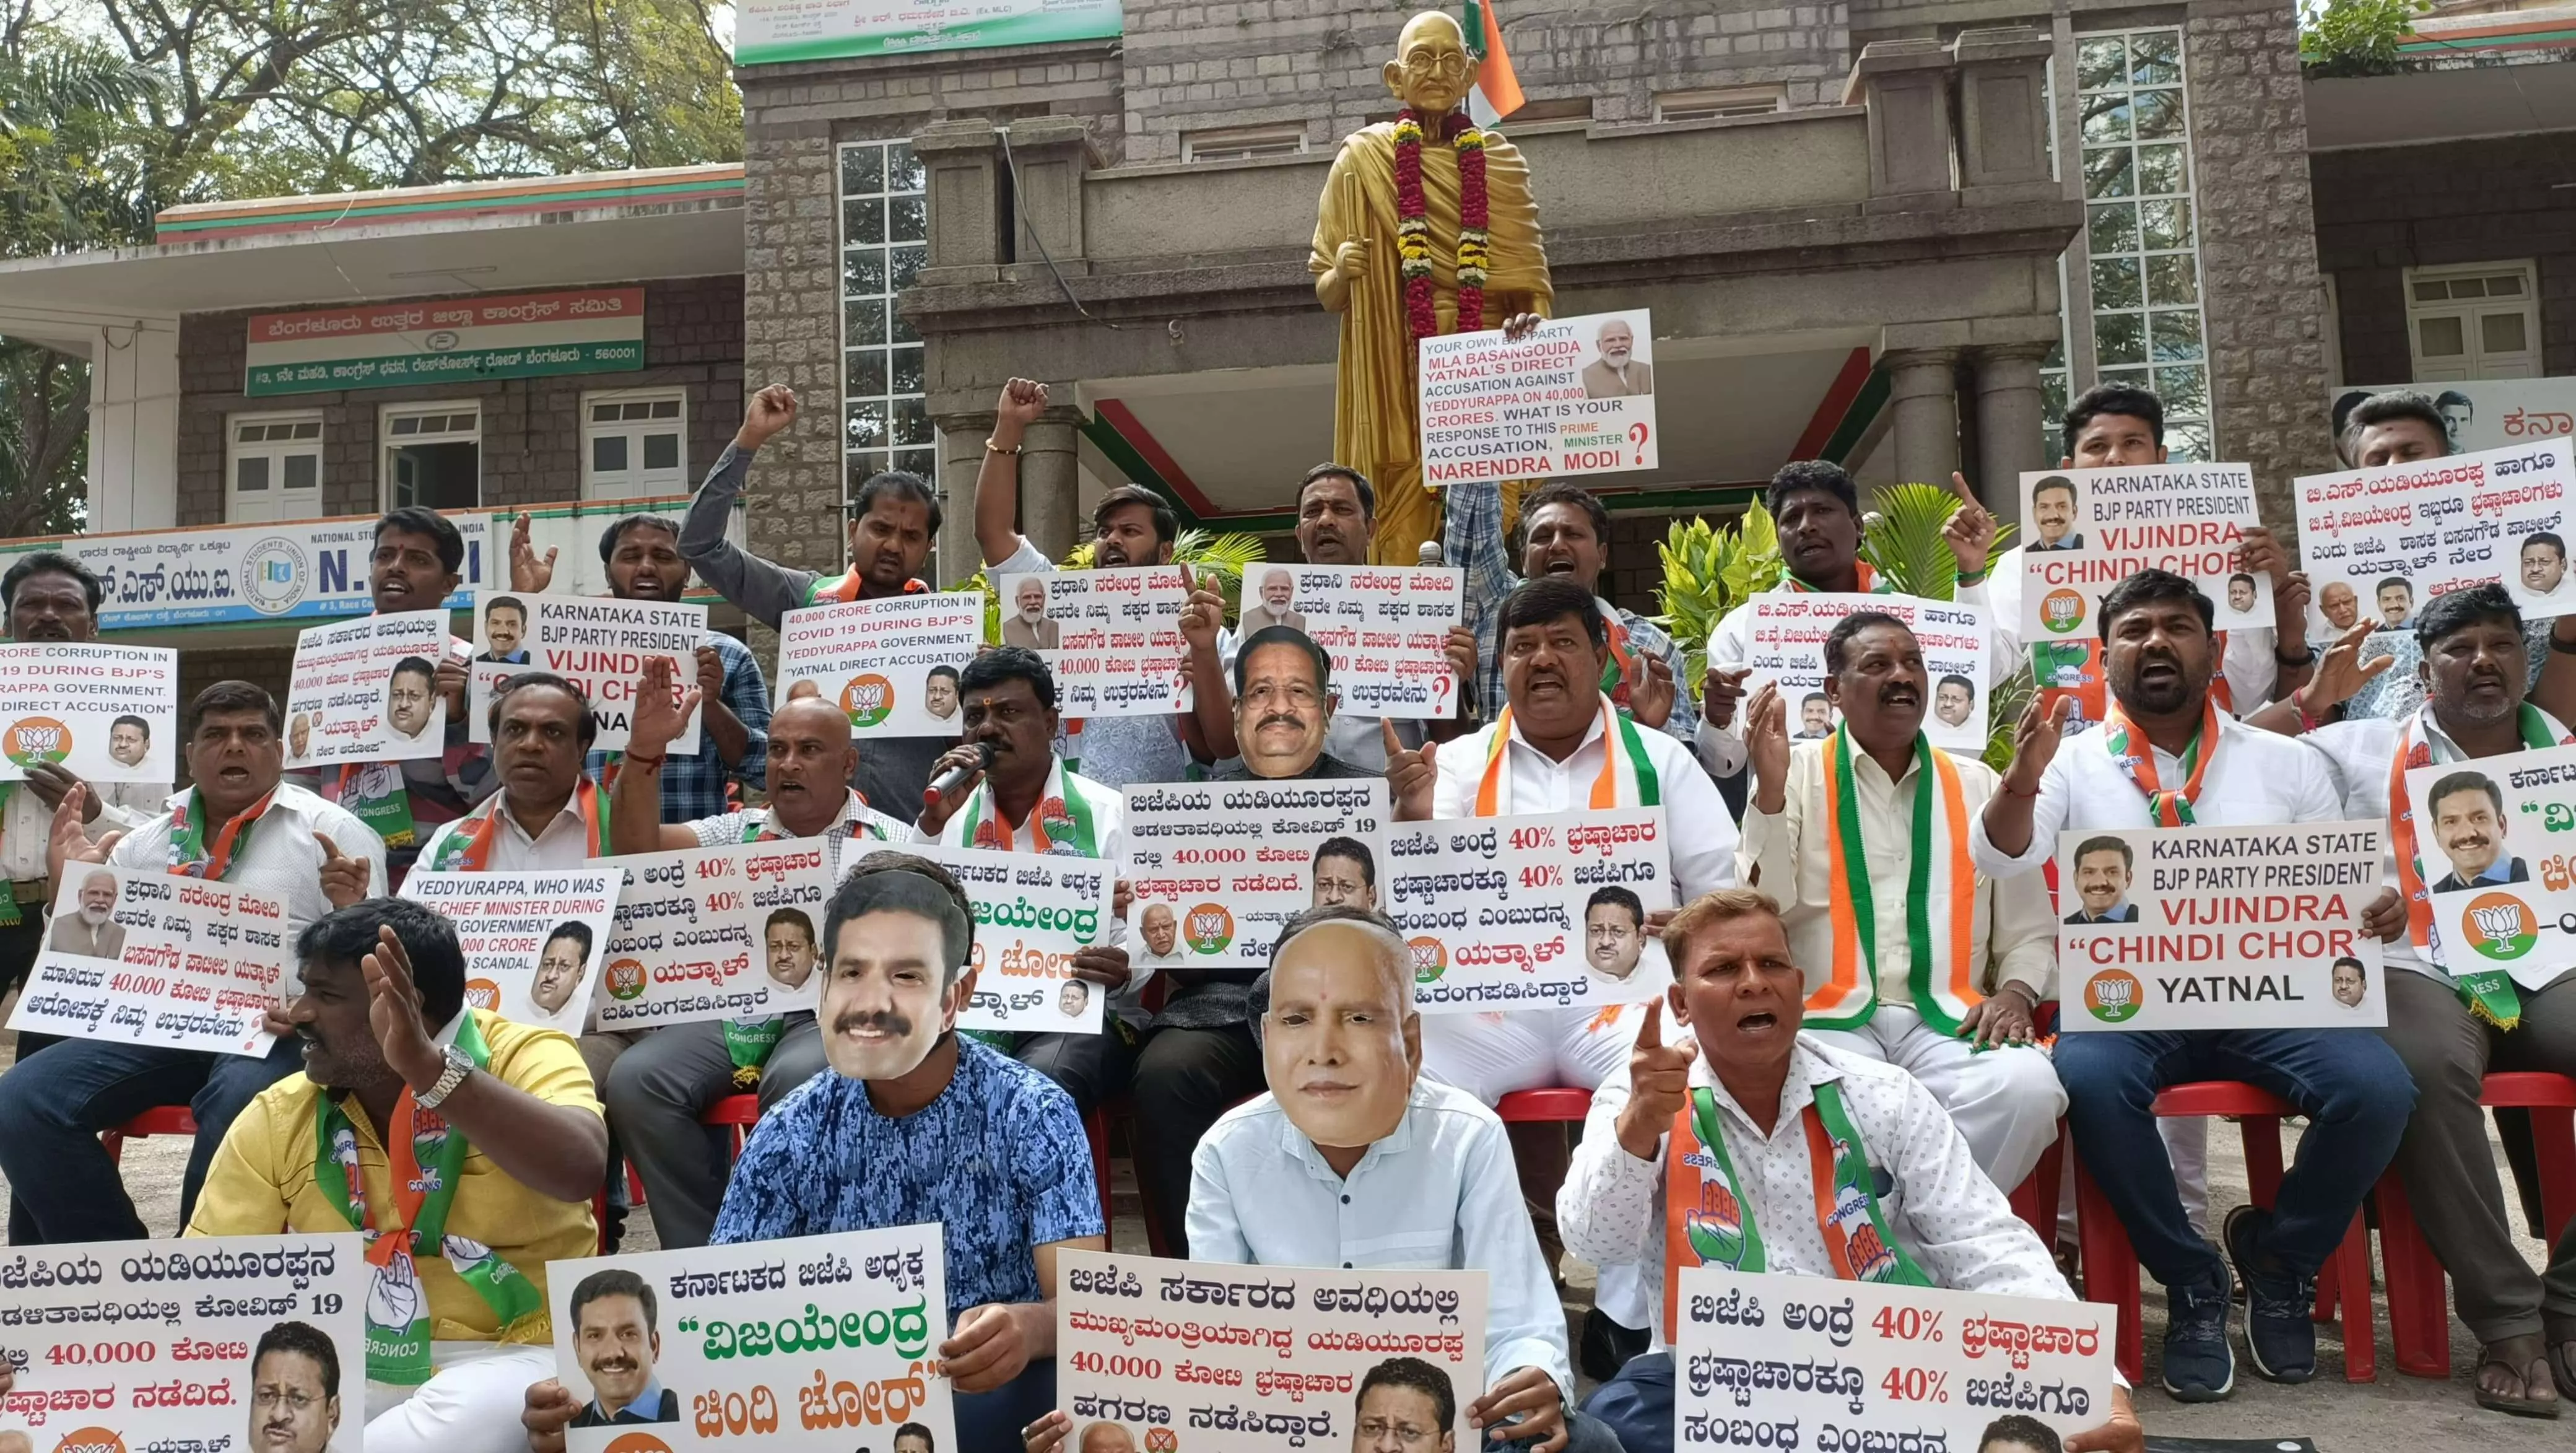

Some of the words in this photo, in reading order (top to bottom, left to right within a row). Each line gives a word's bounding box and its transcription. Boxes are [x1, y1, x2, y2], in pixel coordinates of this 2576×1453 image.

[1425, 342, 1462, 355] YOUR
[1466, 337, 1497, 349] OWN
[1502, 334, 1526, 346] BJP
[1530, 326, 1573, 341] PARTY
[594, 347, 635, 360] 560001
[1429, 355, 1461, 370] MLA
[1466, 341, 1580, 365] BASANGOUDA
[1425, 365, 1506, 382] YATNAL'S
[1512, 356, 1575, 372] DIRECT
[1425, 376, 1511, 398] ACCUSATION
[1515, 372, 1575, 388] AGAINST
[1425, 393, 1518, 412] YEDDYURAPPA
[1523, 391, 1541, 403] ON
[1545, 388, 1583, 401] 40,000
[1426, 412, 1499, 427] CRORES.
[1503, 406, 1551, 421] WHAT
[1556, 405, 1570, 417] IS
[1576, 400, 1623, 414] YOUR
[1427, 427, 1500, 443] RESPONSE
[1504, 425, 1522, 436] TO
[1526, 422, 1556, 435] THIS
[1560, 422, 1598, 434] PRIME
[1427, 440, 1552, 459] ACCUSATION,
[1564, 434, 1623, 448] MINISTER
[1429, 456, 1552, 481] NARENDRA
[1564, 450, 1620, 470] MODI
[2091, 473, 2197, 494] KARNATAKA
[2202, 473, 2248, 489] STATE
[2094, 502, 2121, 521] BJP
[2126, 499, 2172, 519] PARTY
[2177, 495, 2250, 515] PRESIDENT
[311, 531, 354, 544] NATIONAL
[2100, 521, 2243, 551] VIJINDRA
[286, 545, 304, 569] UNION
[243, 569, 265, 606] NATIONAL
[298, 572, 305, 582] OF
[284, 586, 302, 604] INDIA
[541, 603, 645, 624] KARNATAKA
[649, 611, 701, 627] STATE
[789, 611, 825, 625] 40,000
[828, 605, 872, 619] CRORE
[875, 598, 960, 614] CORRUPTION
[964, 596, 976, 607] IN
[542, 626, 568, 644] BJP
[572, 627, 617, 646] PARTY
[621, 630, 698, 651] PRESIDENT
[788, 628, 834, 642] COVID
[840, 626, 856, 635] 19
[861, 618, 922, 632] DURING
[928, 615, 973, 627] BJP'S
[46, 648, 149, 661] CORRUPTION
[154, 653, 168, 661] IN
[786, 640, 877, 660] YEDDYURAPPA
[881, 634, 975, 649] GOVERNMENT.
[1, 666, 20, 675] 19
[28, 665, 105, 676] DURING
[111, 668, 165, 679] BJP'S
[840, 658, 886, 671] DIRECT
[2045, 673, 2093, 682] CONGRESS
[54, 684, 166, 696] GOVERNMENT.
[1, 701, 61, 711] DIRECT
[359, 803, 401, 817] CONGRESS
[1355, 818, 1376, 832] 19
[1391, 831, 1439, 857] ಬಿಜೆಪಿ
[1508, 826, 1556, 850] 40%
[2152, 836, 2299, 860] KARNATAKA
[2305, 832, 2377, 855] STATE
[694, 857, 736, 878] 40%
[1172, 849, 1246, 865] 40,000
[416, 880, 528, 896] YEDDYURAPPA,
[534, 879, 568, 894] WHO
[573, 878, 605, 892] WAS
[1518, 865, 1563, 888] 40%
[2154, 868, 2189, 891] BJP
[2196, 865, 2259, 889] PARTY
[2266, 862, 2374, 887] PRESIDENT
[439, 901, 481, 915] CHIEF
[484, 901, 549, 915] MINISTER
[552, 899, 604, 914] DURING
[705, 891, 744, 912] 40%
[2160, 894, 2349, 925] VIJINDRA
[460, 919, 554, 933] GOVERNMENT,
[489, 938, 538, 952] CRORE
[472, 957, 533, 969] SCANDAL.
[109, 972, 165, 996] 40,000
[2157, 975, 2304, 1003] YATNAL
[728, 1031, 776, 1043] CONGRESS
[798, 1252, 853, 1286] ಬಿಜೆಪಿ
[1069, 1265, 1142, 1297] ಬಿಜೆಪಿ
[311, 1294, 343, 1315] 19
[1690, 1288, 1764, 1327] ಬಿಜೆಪಿ
[1872, 1306, 1944, 1343] 40%
[45, 1341, 155, 1365] 40,000
[1069, 1351, 1162, 1380] 40,000
[1881, 1367, 1949, 1404] 40%
